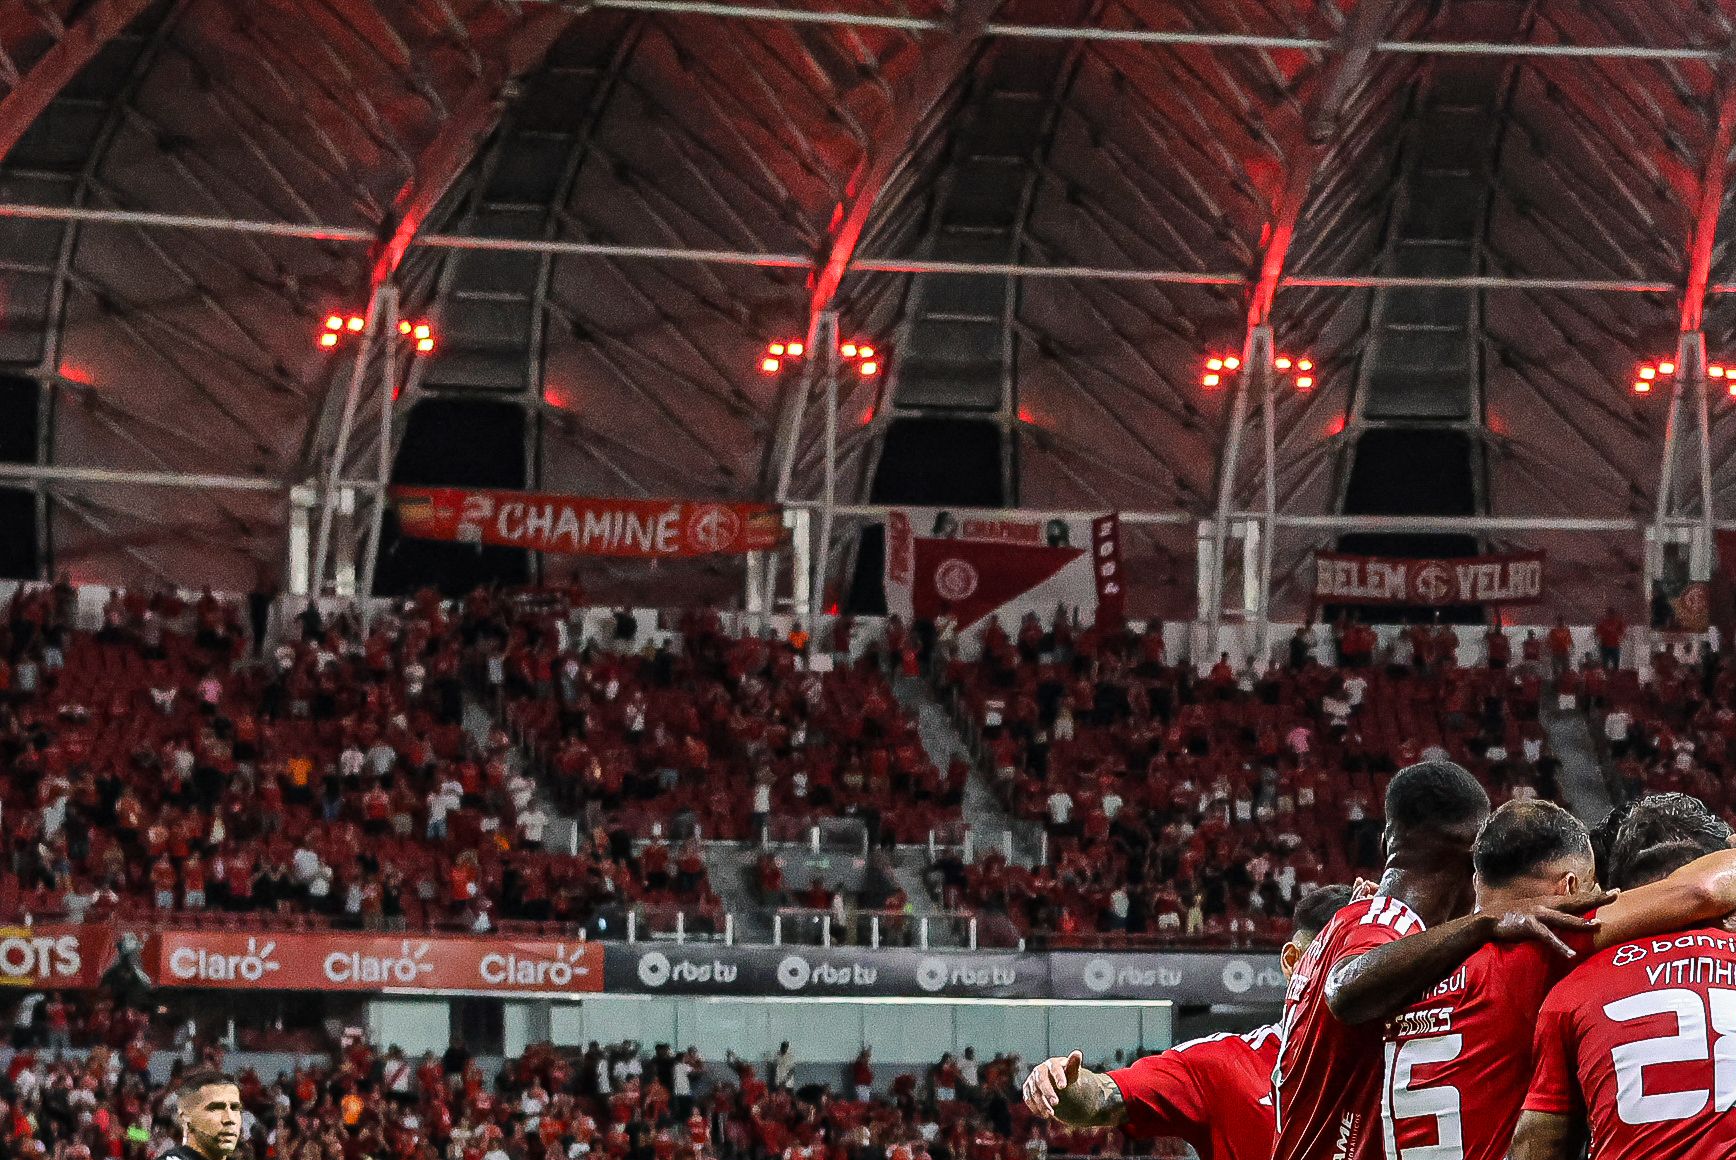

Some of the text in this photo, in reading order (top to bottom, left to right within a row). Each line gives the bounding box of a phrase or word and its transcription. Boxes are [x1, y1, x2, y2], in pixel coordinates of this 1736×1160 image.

[497, 500, 683, 552] CHAMINÉ
[1316, 556, 1542, 599] BELÉM VELHO
[169, 944, 264, 981] Claro
[323, 948, 417, 983] Claro
[479, 949, 572, 985] Claro
[1395, 1006, 1455, 1037] GOMES
